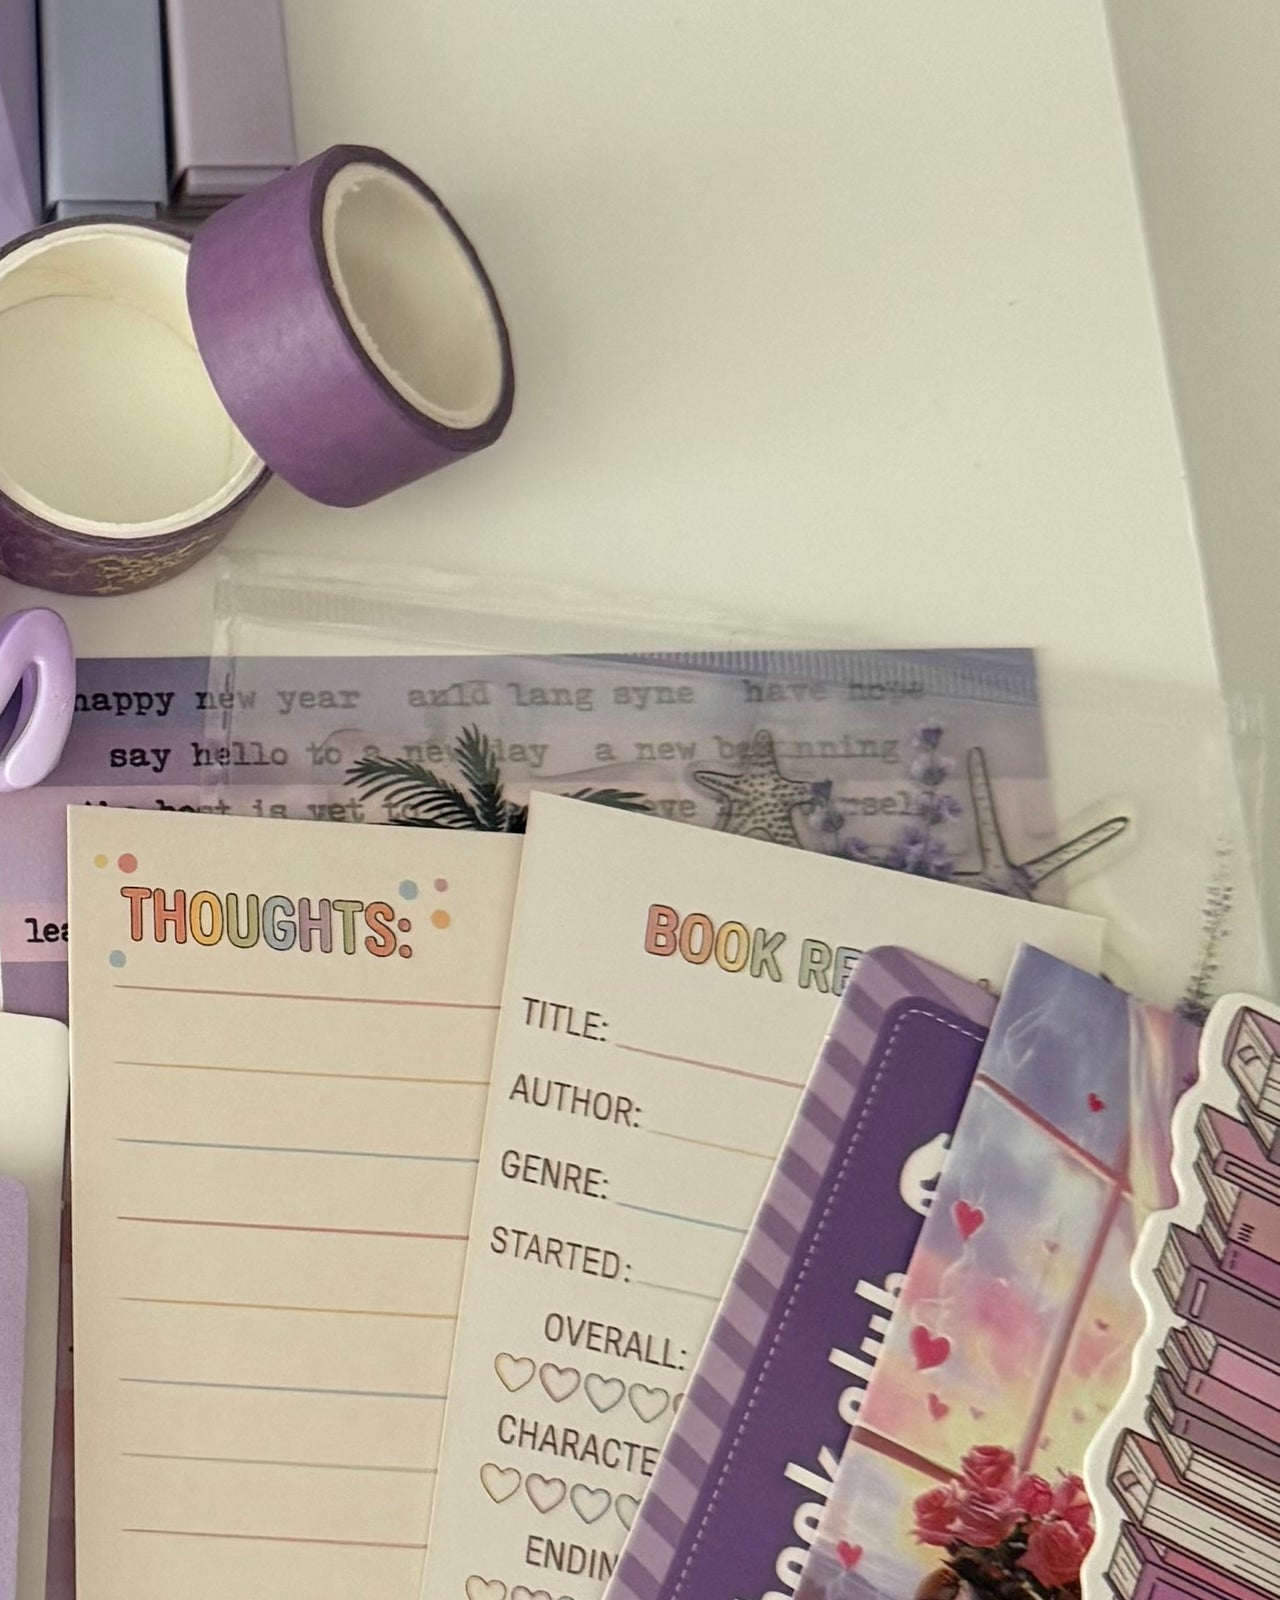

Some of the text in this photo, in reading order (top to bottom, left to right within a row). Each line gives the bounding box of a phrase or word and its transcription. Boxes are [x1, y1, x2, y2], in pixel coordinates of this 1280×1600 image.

[195, 690, 258, 711] new
[276, 688, 361, 716] year
[506, 682, 595, 713] lang
[612, 683, 697, 711] syne
[109, 746, 172, 774] say
[190, 740, 290, 768] hello
[307, 740, 343, 766] to
[595, 742, 617, 761] a
[634, 741, 697, 761] new
[712, 733, 900, 764] benning
[119, 885, 413, 959] THOUGHTS:
[644, 903, 864, 997] BOOK RE
[521, 996, 610, 1043] TITLE:
[508, 1072, 644, 1129] AUTHOR:
[500, 1148, 610, 1200] GENRE:
[489, 1225, 633, 1284] STARTED:
[543, 1311, 691, 1371] OVERALL:
[496, 1413, 661, 1477] CHARACTE
[524, 1535, 620, 1582] ENDIN
